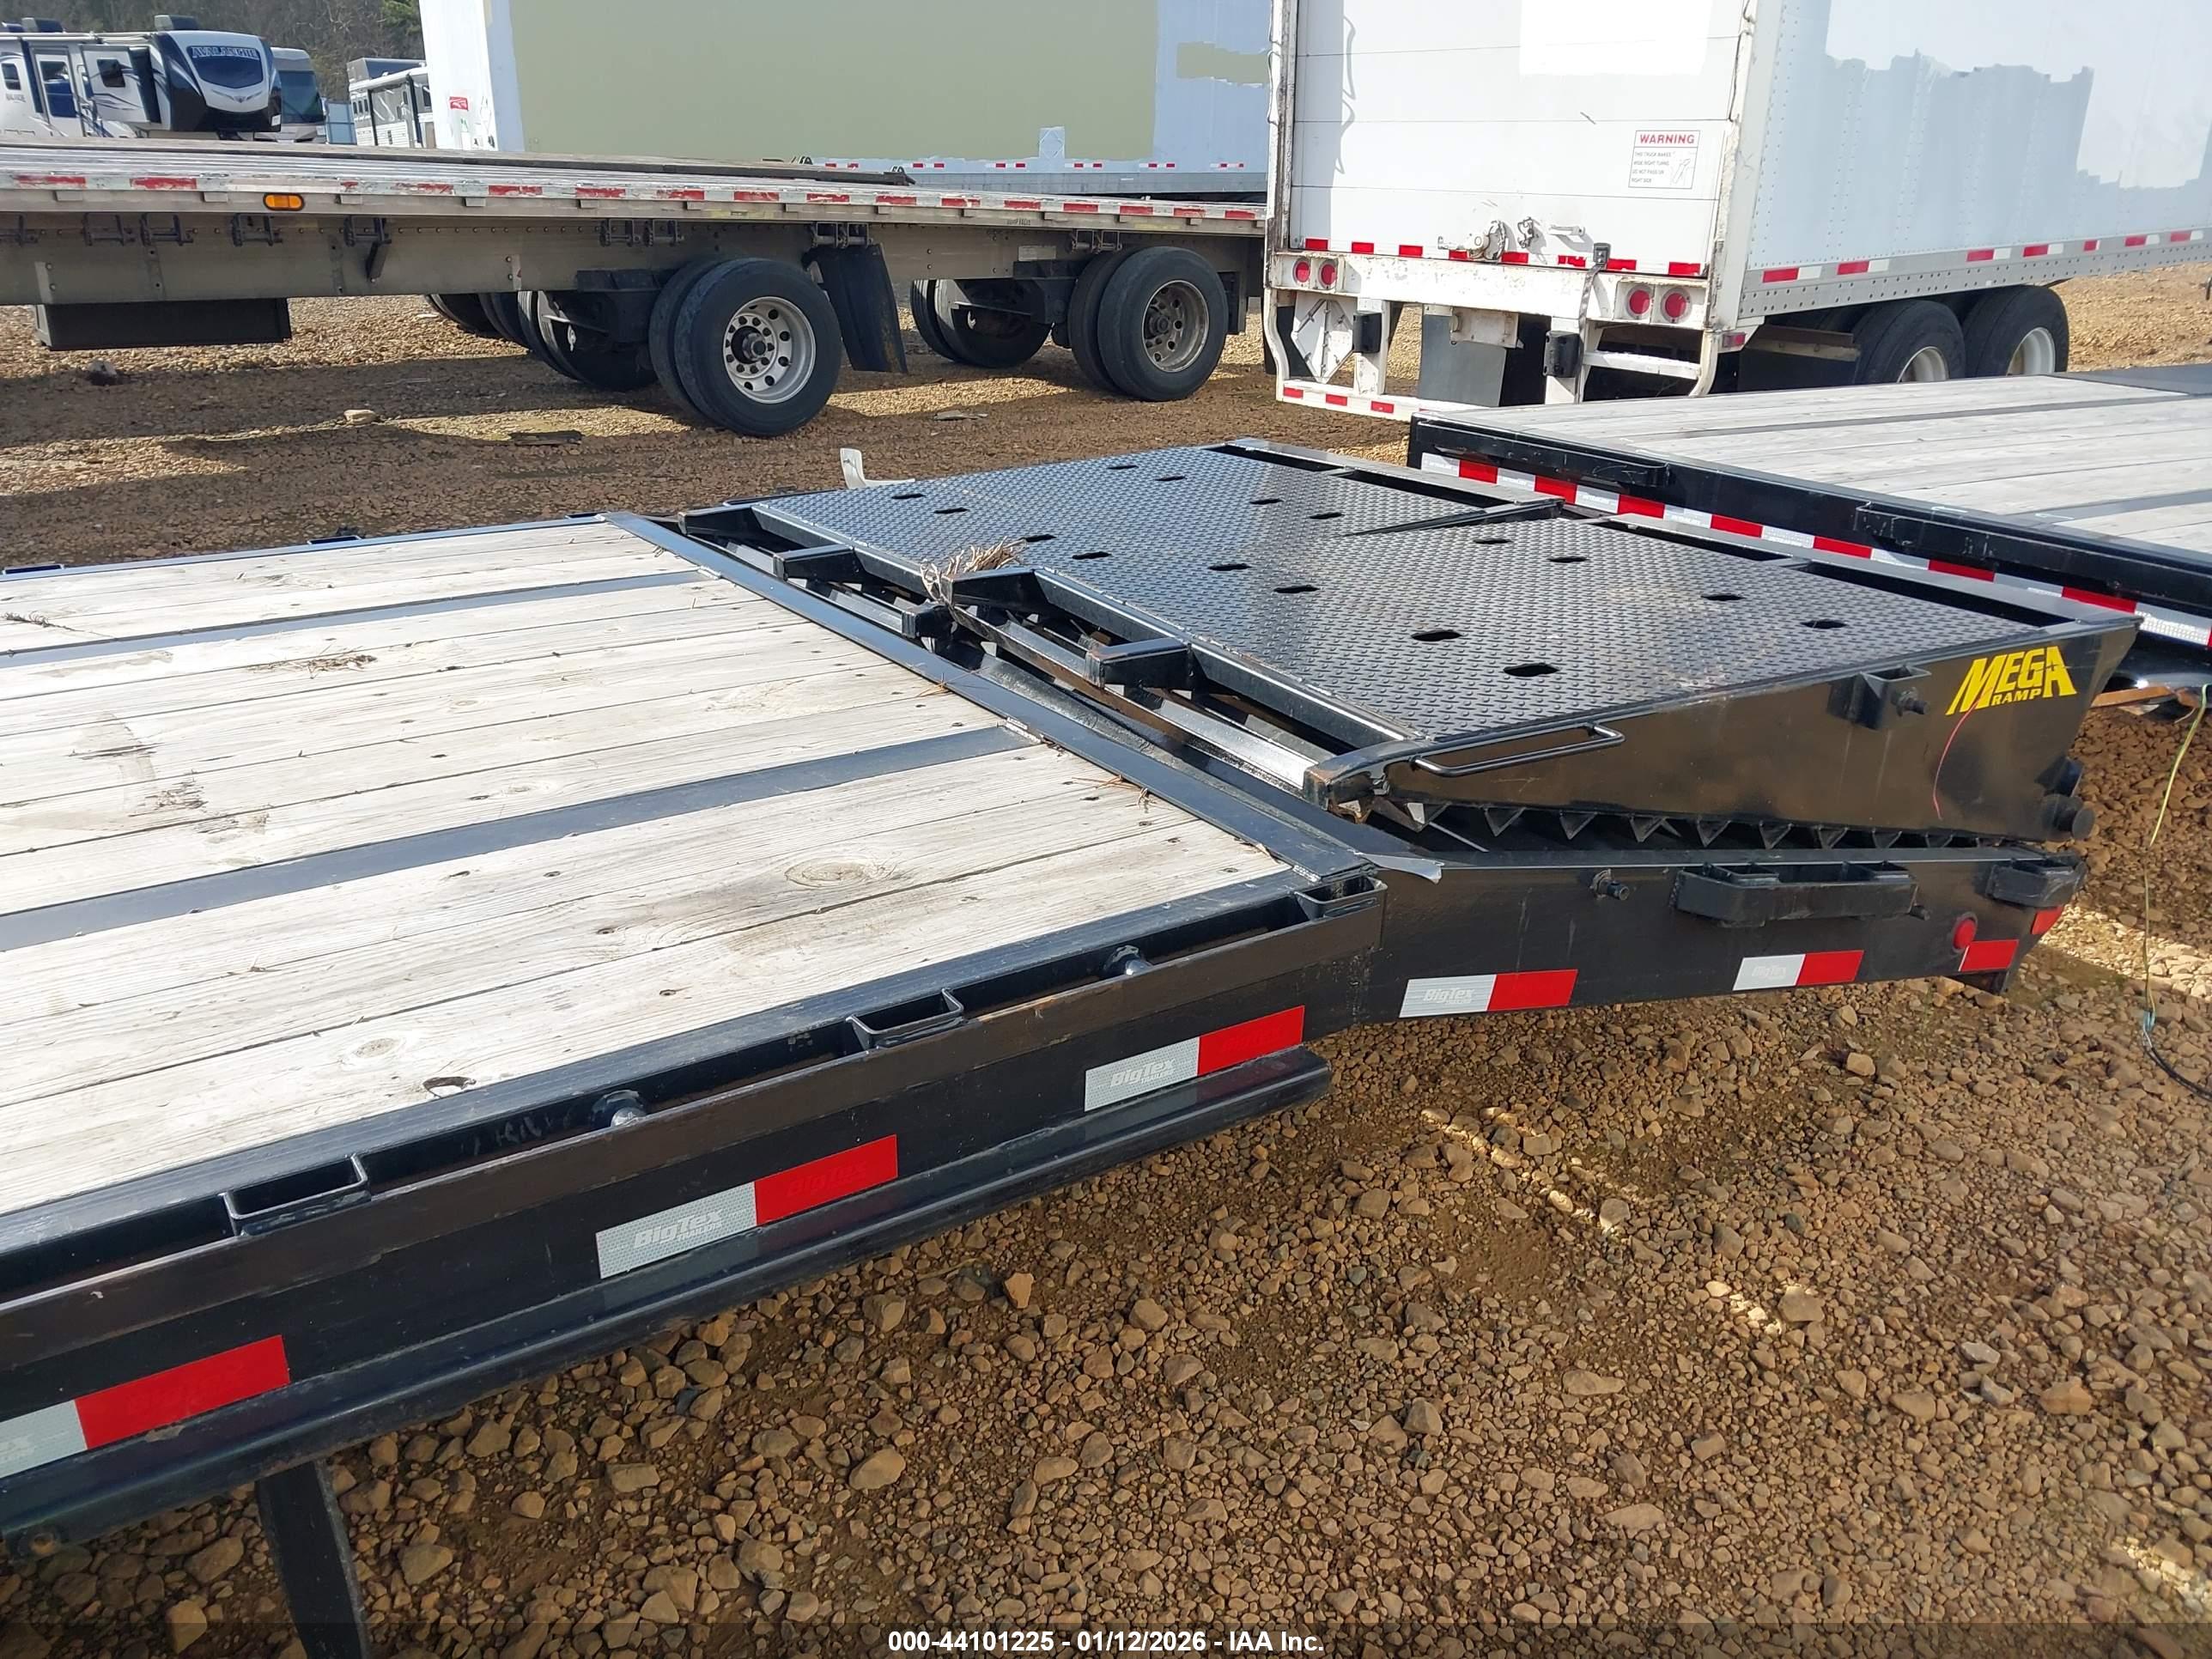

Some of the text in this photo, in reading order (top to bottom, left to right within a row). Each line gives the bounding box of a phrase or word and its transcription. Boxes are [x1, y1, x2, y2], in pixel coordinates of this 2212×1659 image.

[1639, 134, 1695, 144] WARNING
[1945, 645, 2078, 717] MEGA
[1990, 688, 2042, 707] RAMP
[1109, 1058, 1176, 1088] BigTex
[633, 1208, 723, 1249] BigTex
